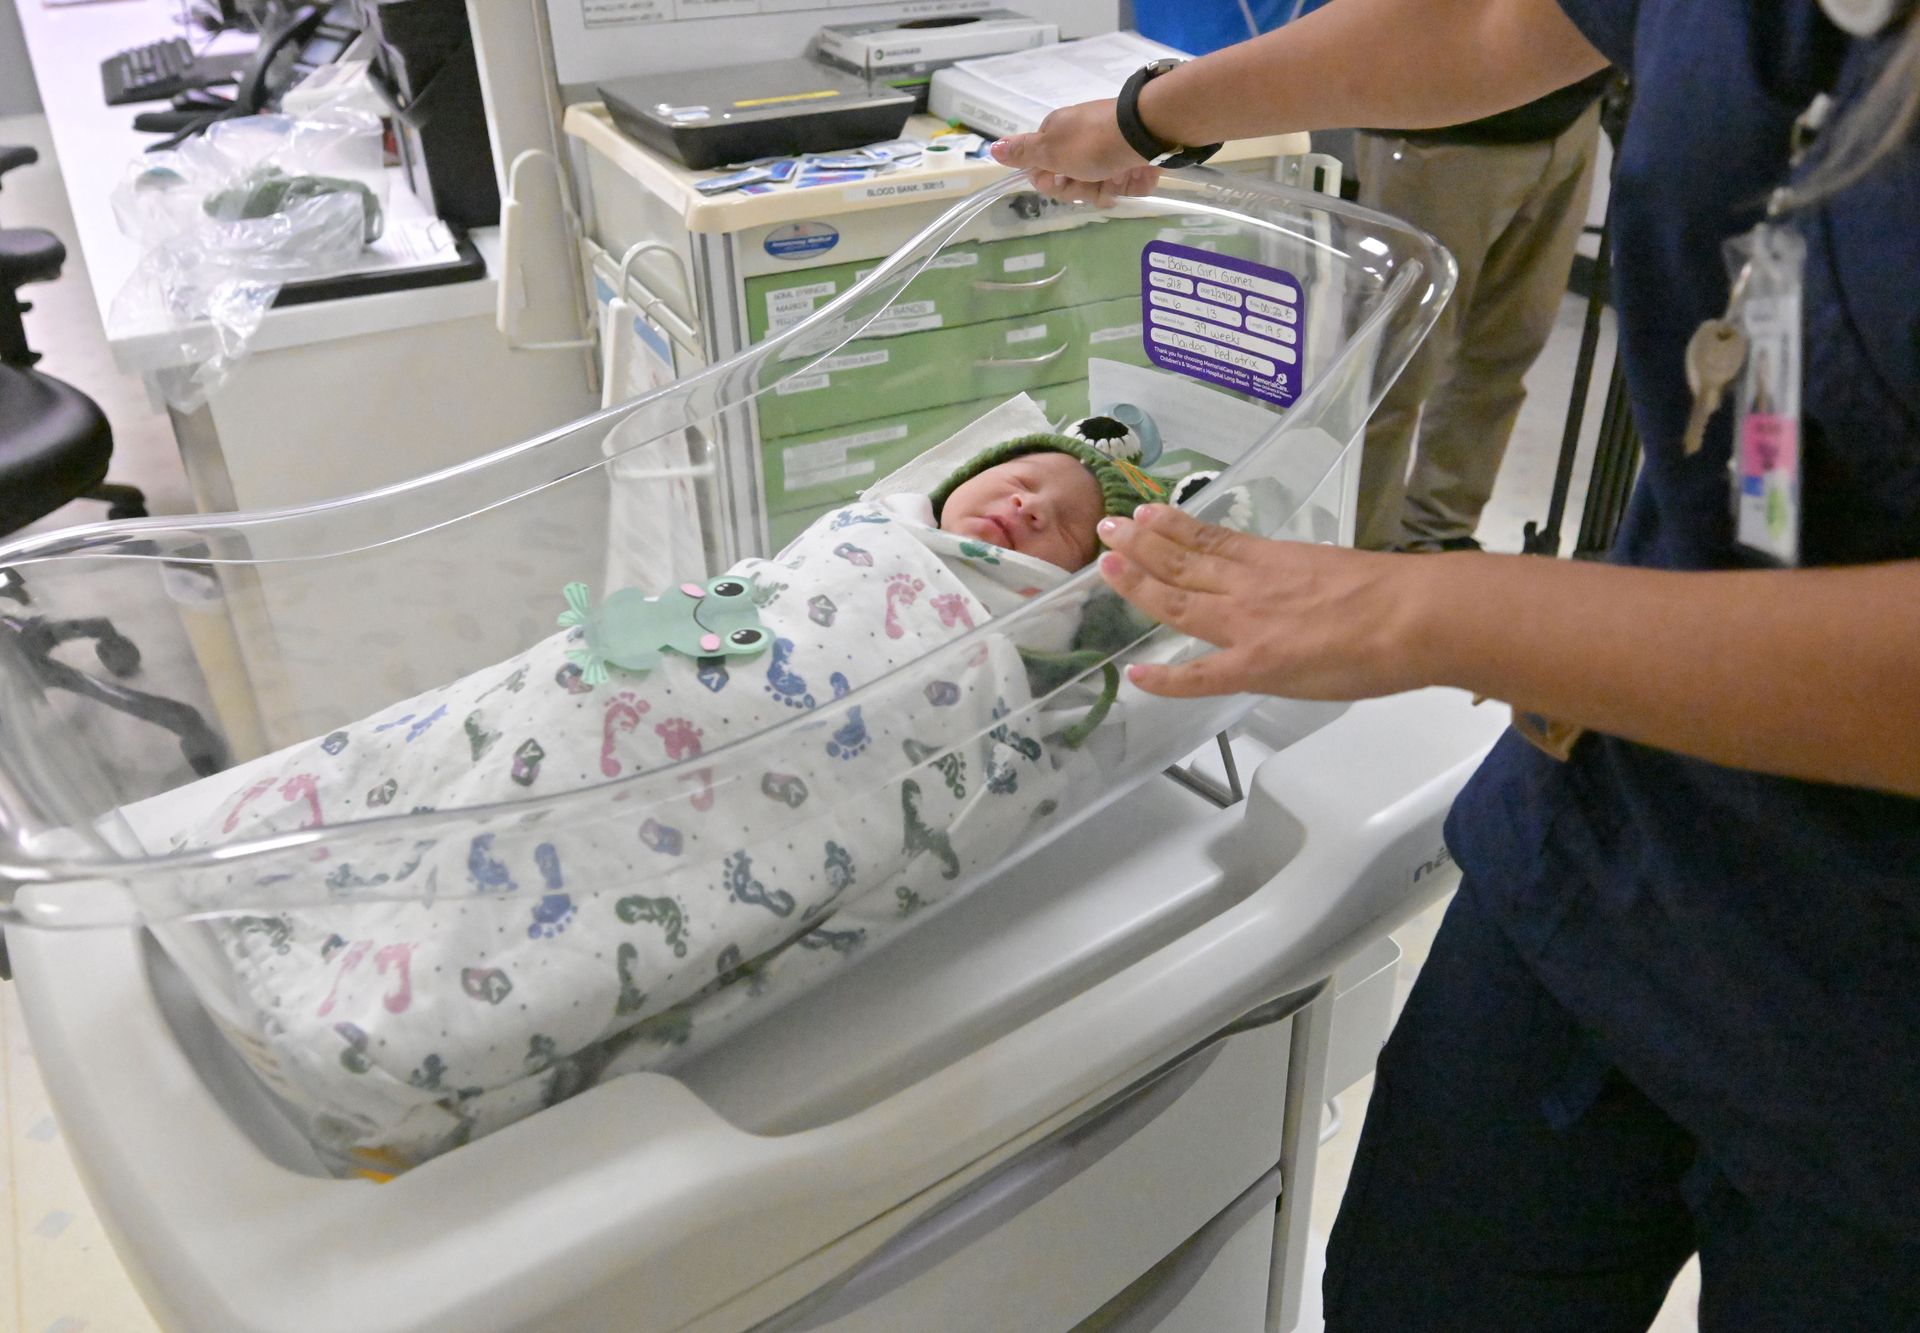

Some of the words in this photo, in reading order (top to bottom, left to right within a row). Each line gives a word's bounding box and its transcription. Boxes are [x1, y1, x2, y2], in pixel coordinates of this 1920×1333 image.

[866, 187, 895, 198] BLOOD
[1167, 256, 1193, 275] Baby
[1197, 263, 1217, 279] Girl
[1166, 277, 1182, 290] 218
[1194, 321, 1207, 335] 39
[1210, 331, 1240, 346] weeks
[1154, 346, 1168, 355] Thank
[1168, 350, 1177, 358] you
[1183, 355, 1204, 366] choosing
[1159, 354, 1182, 367] Children's
[1205, 368, 1225, 380] Hospital
[1224, 374, 1236, 384] Long
